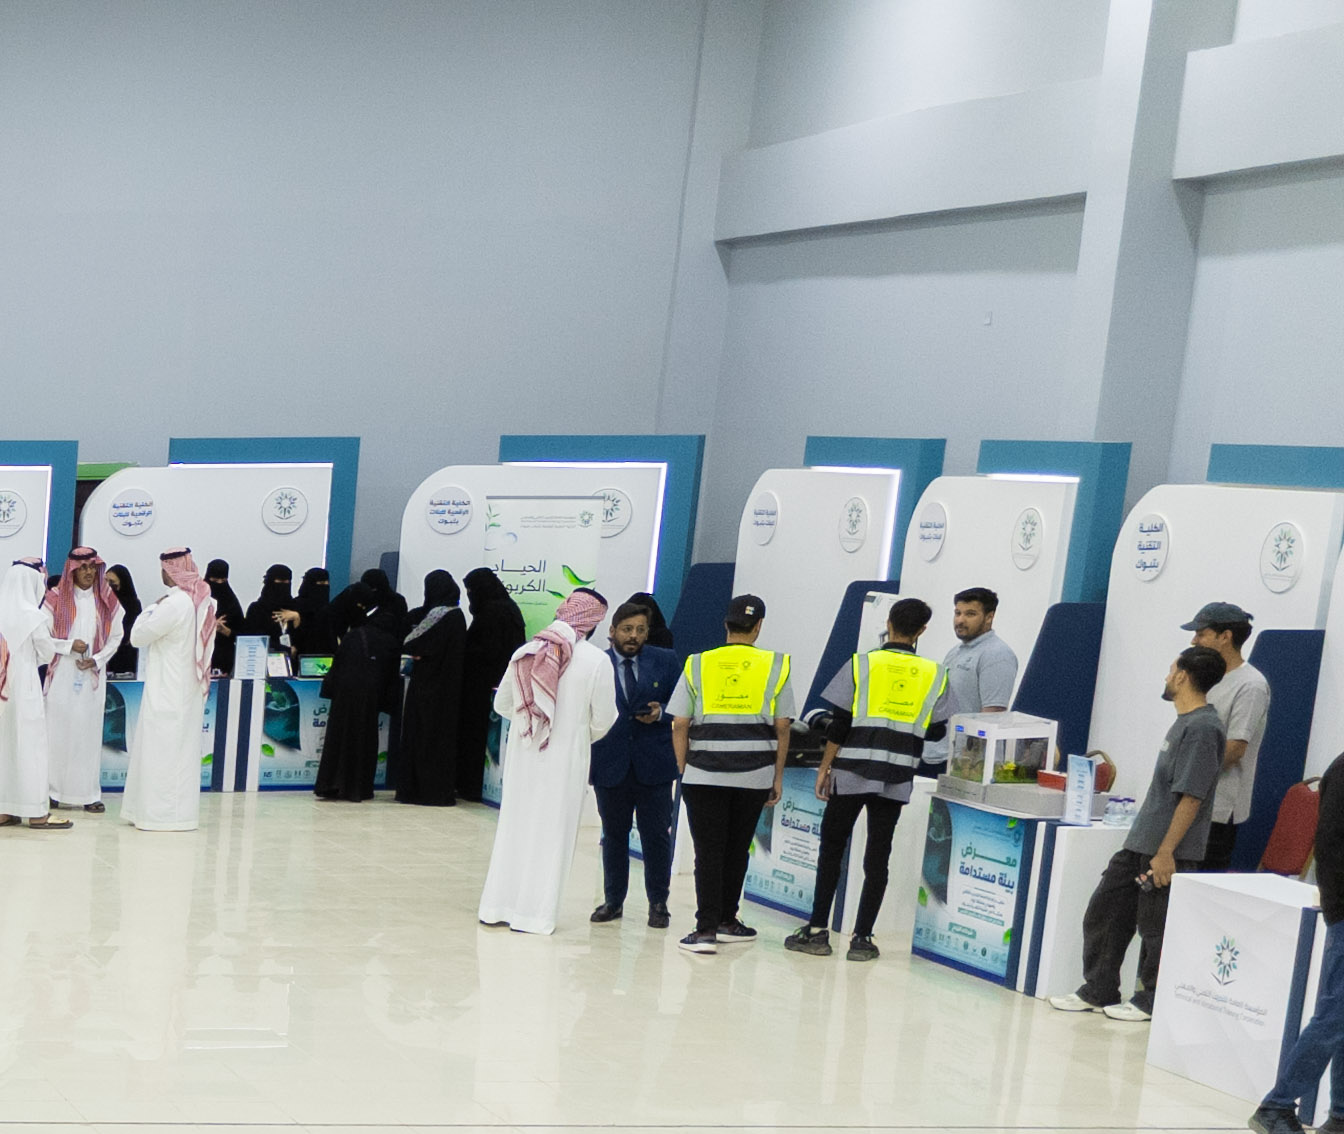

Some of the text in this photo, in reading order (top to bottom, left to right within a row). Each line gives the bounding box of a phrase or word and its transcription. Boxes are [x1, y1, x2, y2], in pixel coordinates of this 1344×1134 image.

[1139, 522, 1164, 537] الكلية
[1137, 540, 1161, 555] التقنية
[1135, 558, 1159, 573] بتبوك
[958, 861, 997, 884] مستدامة
